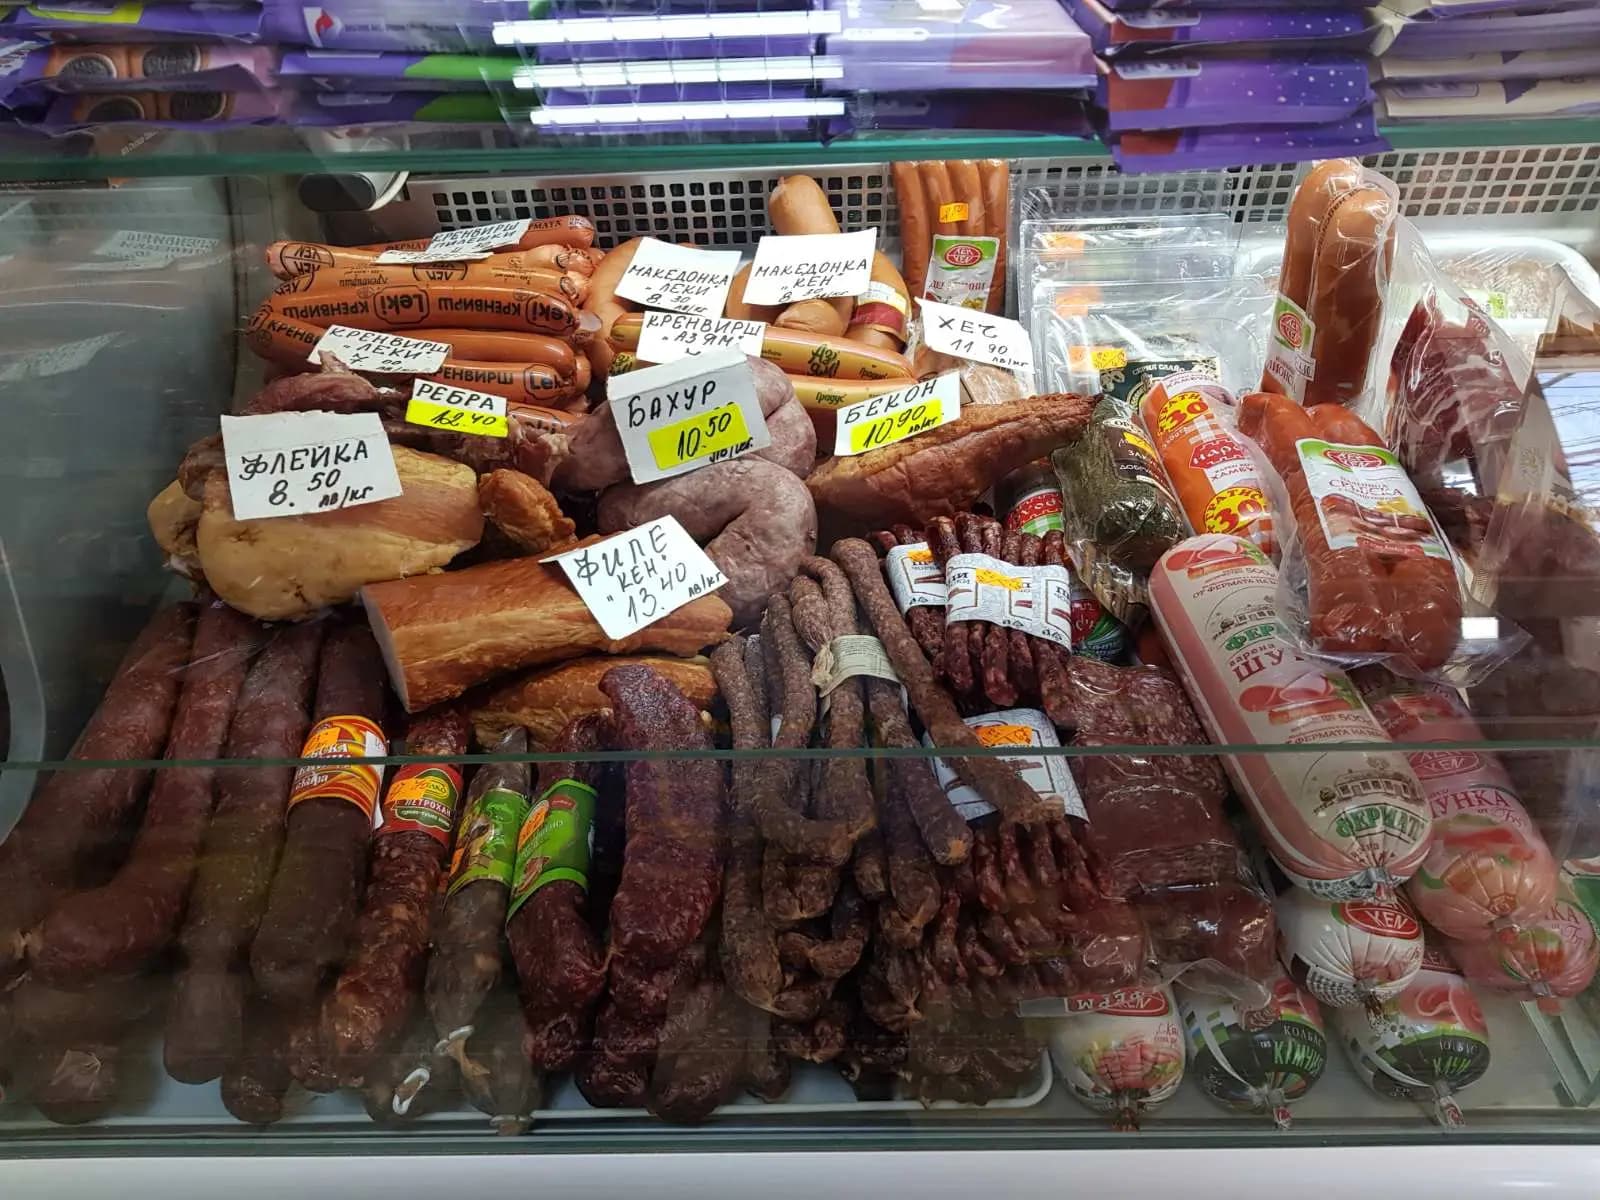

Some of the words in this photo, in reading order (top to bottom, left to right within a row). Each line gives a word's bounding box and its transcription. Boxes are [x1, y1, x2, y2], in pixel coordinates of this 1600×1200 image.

[627, 264, 729, 286] МАКЕДОНКА
[754, 258, 867, 277] МАКЕДОНКА
[283, 300, 370, 319] КРЕНВИРШ
[438, 296, 521, 316] КРЕНВИРШ
[267, 319, 321, 347] КРЕНВ
[646, 314, 762, 336] КРЕНВИРШ
[329, 326, 449, 353] КРЕНВИРШ
[415, 383, 494, 411] РЕБРА
[628, 380, 716, 428] БАХУР
[844, 378, 937, 425] БЕКОН
[239, 439, 369, 481] ФЛЕЙКА
[573, 524, 668, 586] ФИЛЕ
[1365, 909, 1409, 930] KEN
